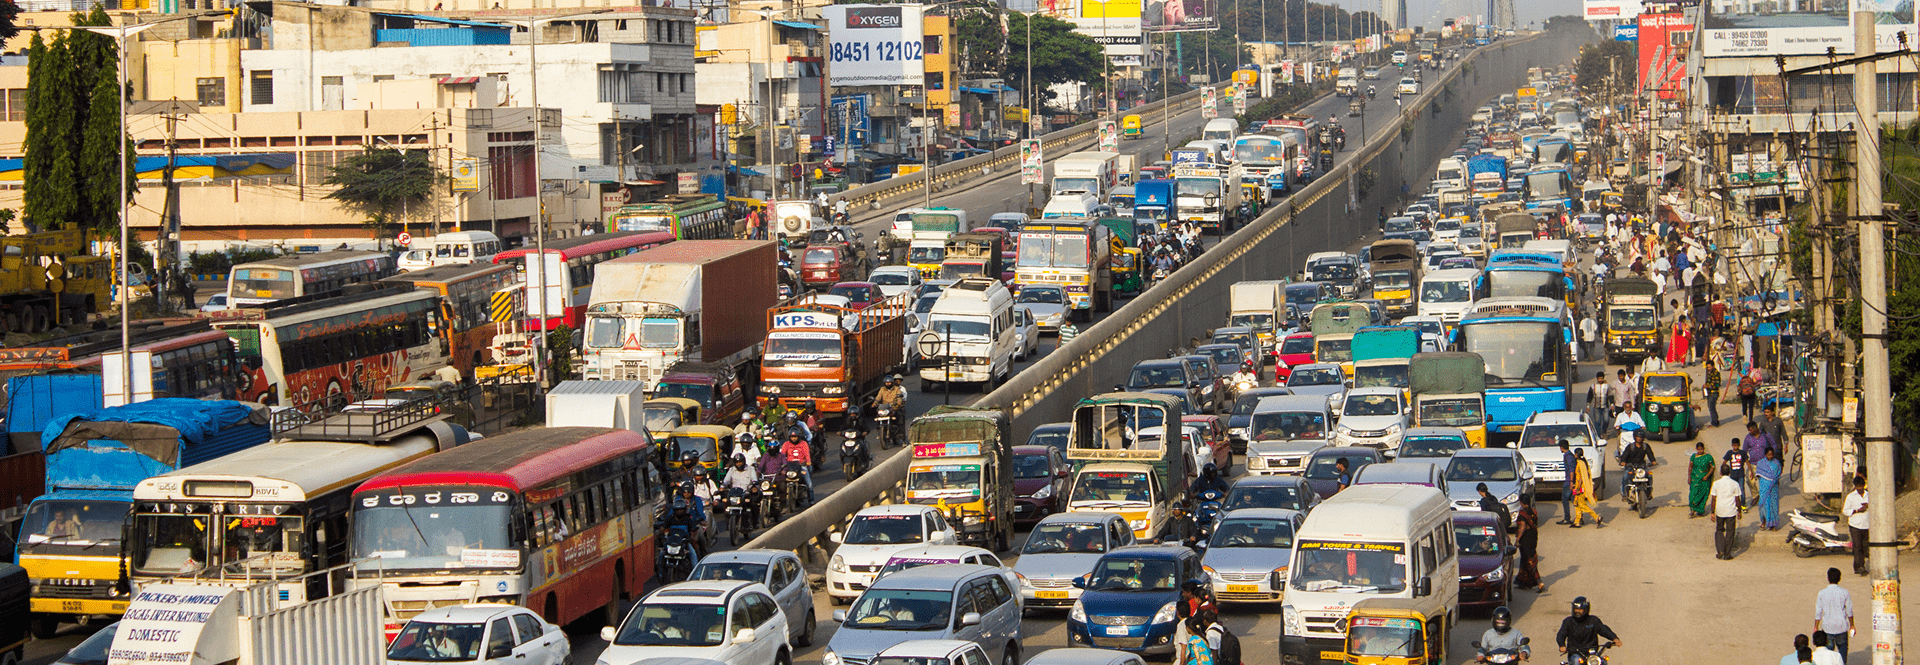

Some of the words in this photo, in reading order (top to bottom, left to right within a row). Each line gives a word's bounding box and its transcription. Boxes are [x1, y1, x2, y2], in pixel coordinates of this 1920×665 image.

[849, 15, 899, 25] OXYGEN
[876, 41, 922, 61] 12102
[358, 311, 407, 328] Legacy
[776, 316, 815, 326] KPS
[255, 488, 278, 496] BDVL
[135, 592, 180, 604] PACKERS
[123, 608, 151, 620] LOCAL
[127, 629, 181, 642] DOMESTIC
